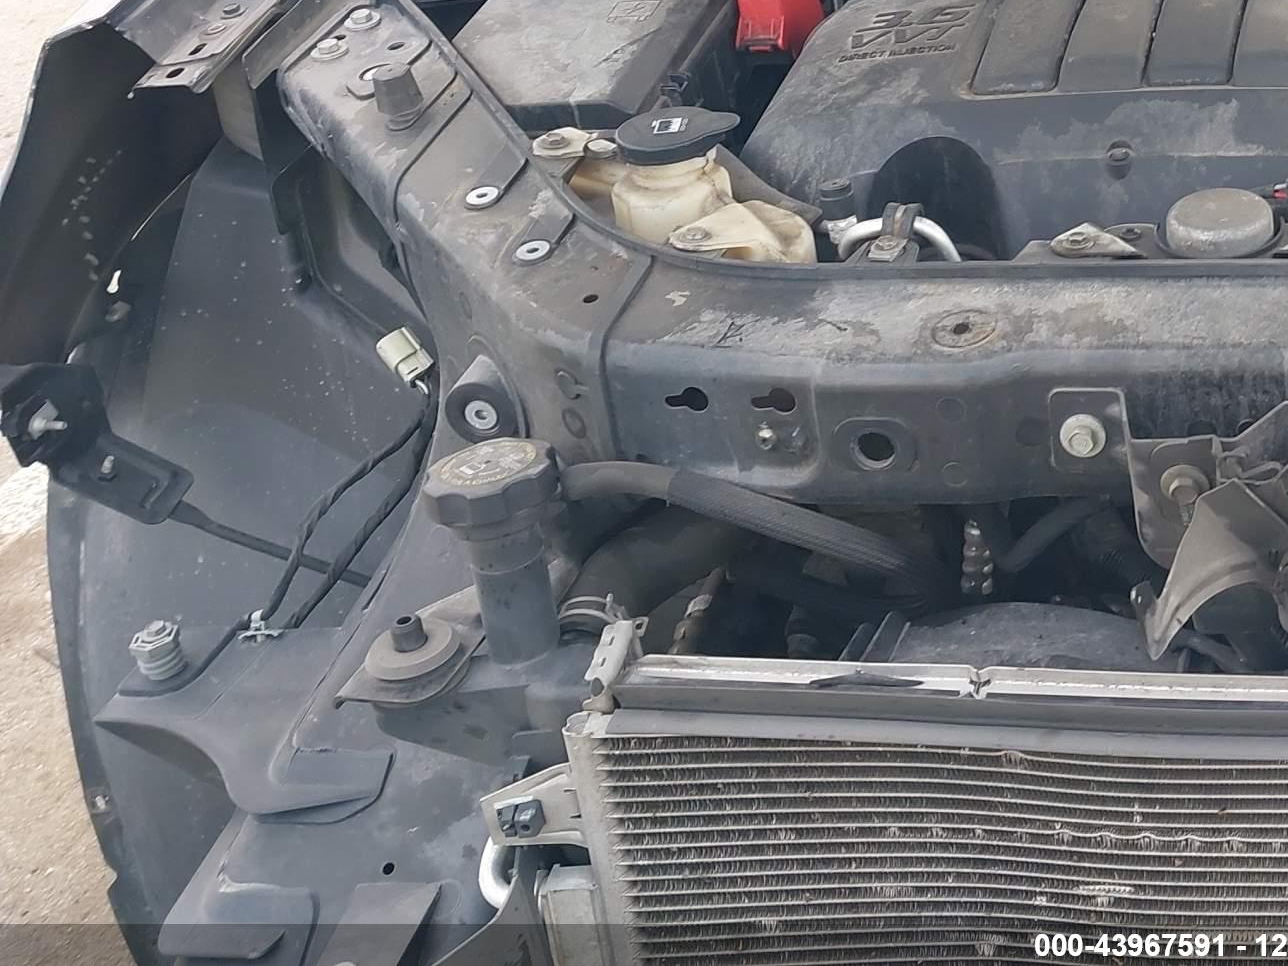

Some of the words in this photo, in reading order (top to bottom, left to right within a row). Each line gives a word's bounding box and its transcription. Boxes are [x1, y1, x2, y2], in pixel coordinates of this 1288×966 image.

[855, 2, 976, 33] 3.6
[850, 22, 967, 50] VVT
[838, 50, 887, 64] DIRECT
[887, 43, 957, 58] INJECTION
